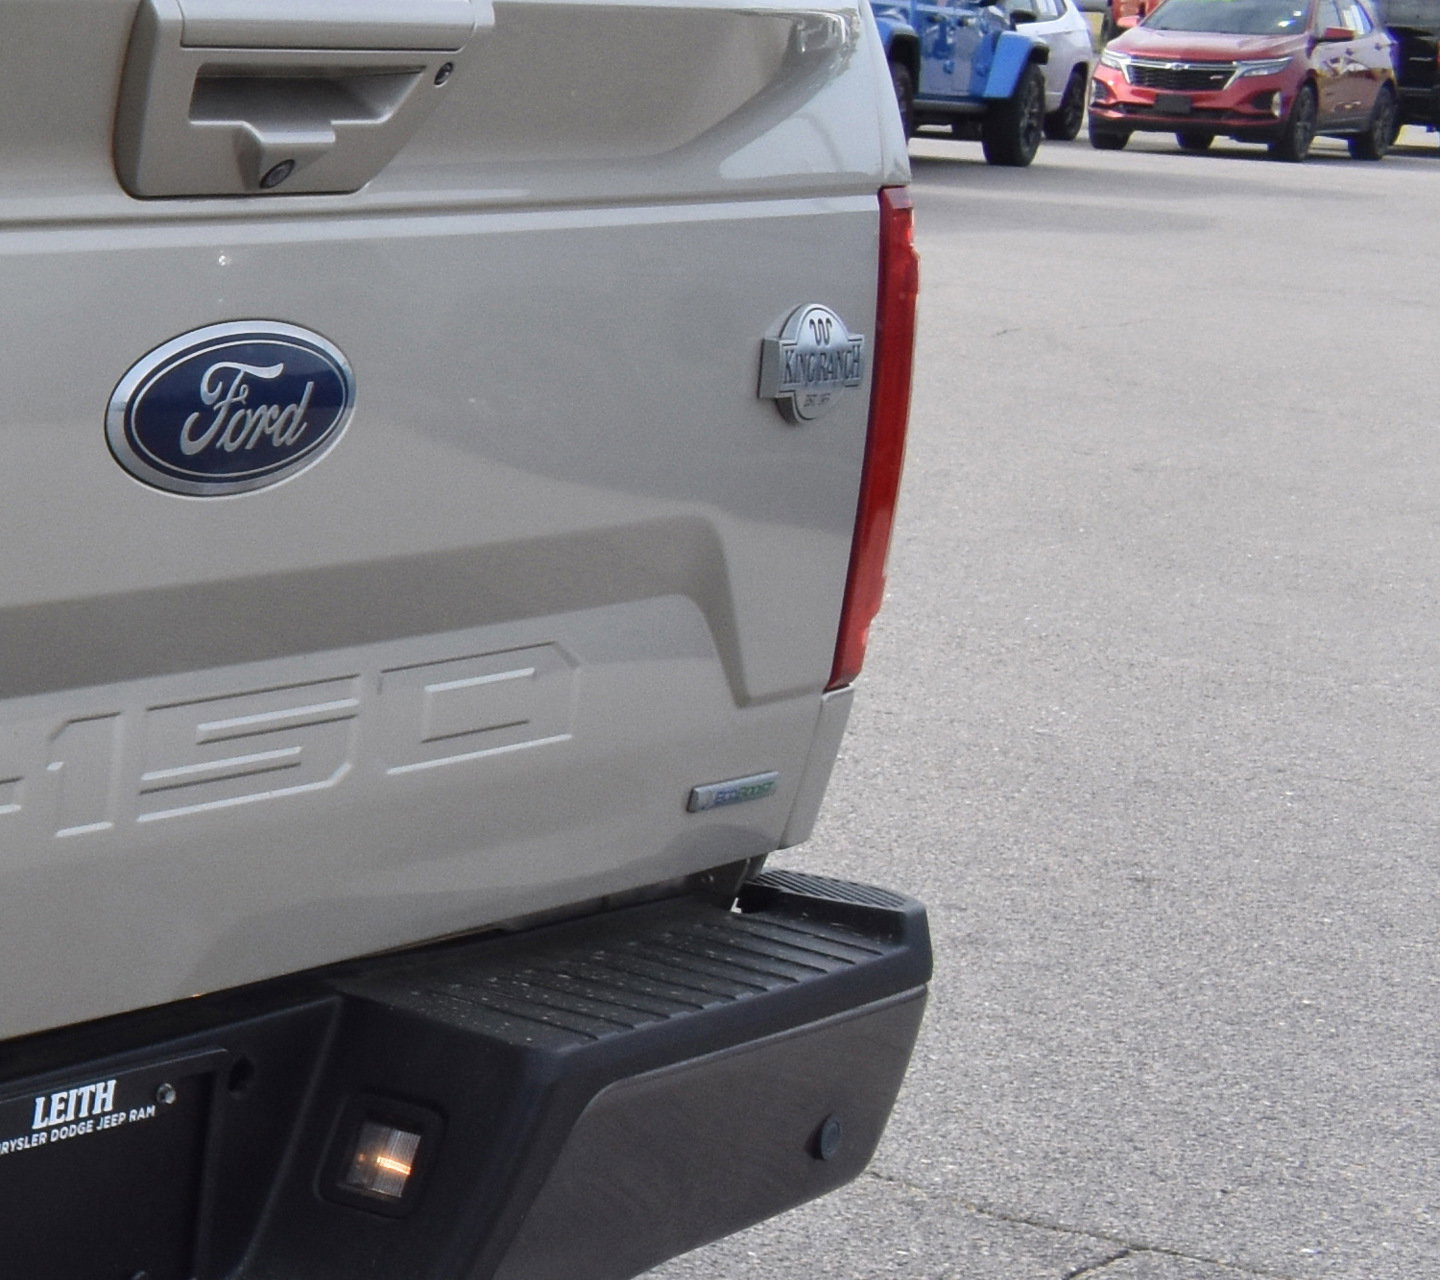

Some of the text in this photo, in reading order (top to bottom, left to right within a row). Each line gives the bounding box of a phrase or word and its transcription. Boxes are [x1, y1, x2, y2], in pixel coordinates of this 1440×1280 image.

[180, 361, 314, 456] Ford
[31, 1079, 117, 1130] LEITH
[50, 1120, 94, 1142] DODGE
[95, 1112, 127, 1130] JEEP
[129, 1104, 157, 1122] RAM
